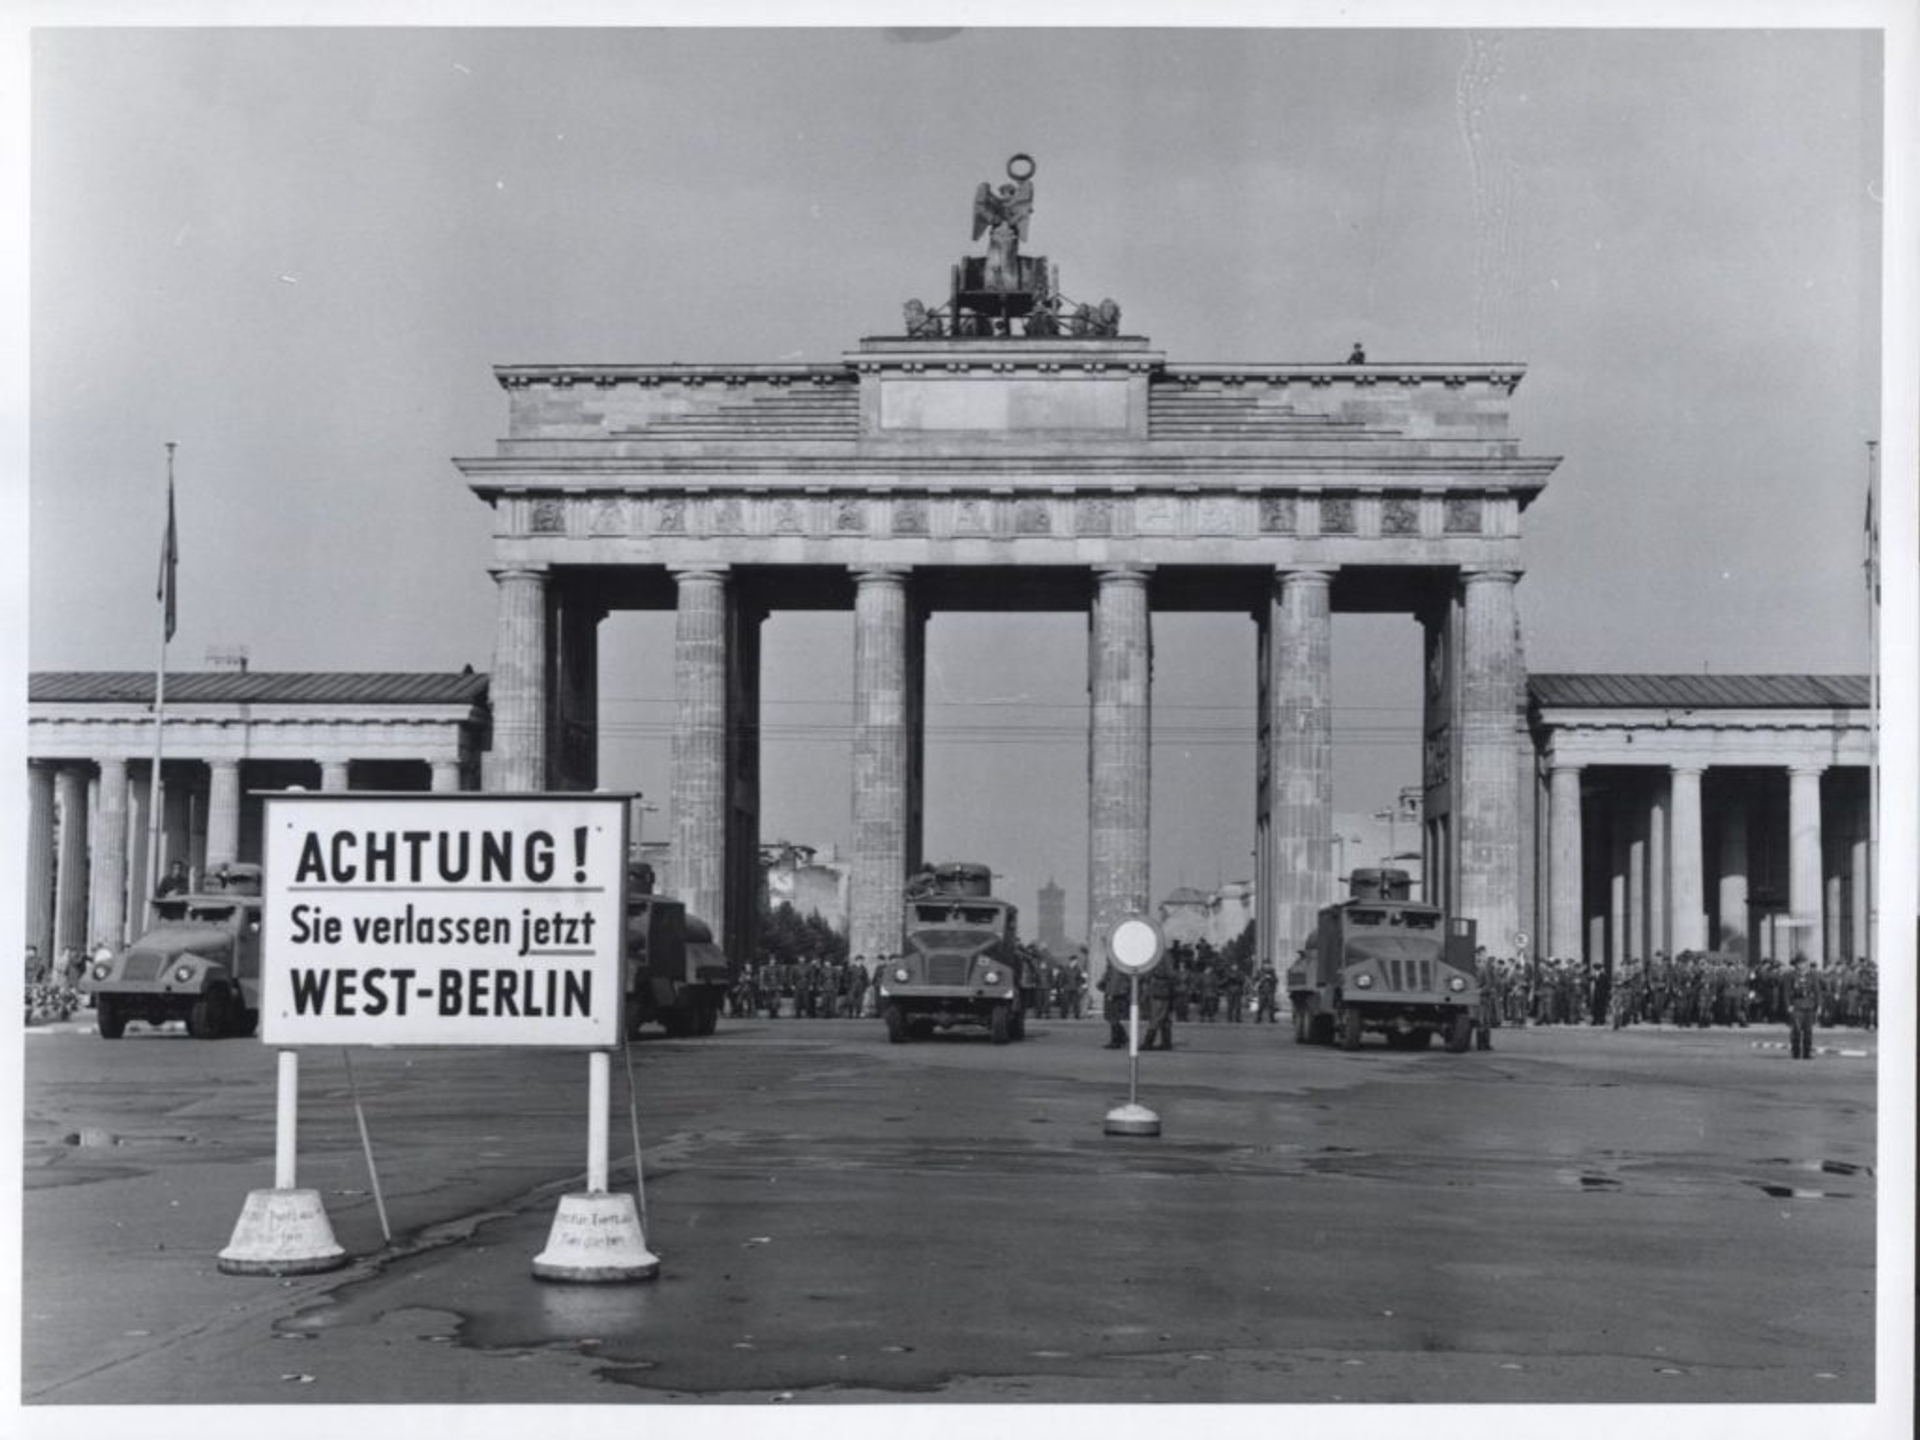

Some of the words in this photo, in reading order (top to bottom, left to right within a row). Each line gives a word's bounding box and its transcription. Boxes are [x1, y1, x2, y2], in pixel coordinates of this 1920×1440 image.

[291, 904, 342, 944] Sie
[353, 903, 511, 945] verlassen
[518, 908, 596, 957] jetzt
[290, 967, 592, 1018] WEST-BERLIN
